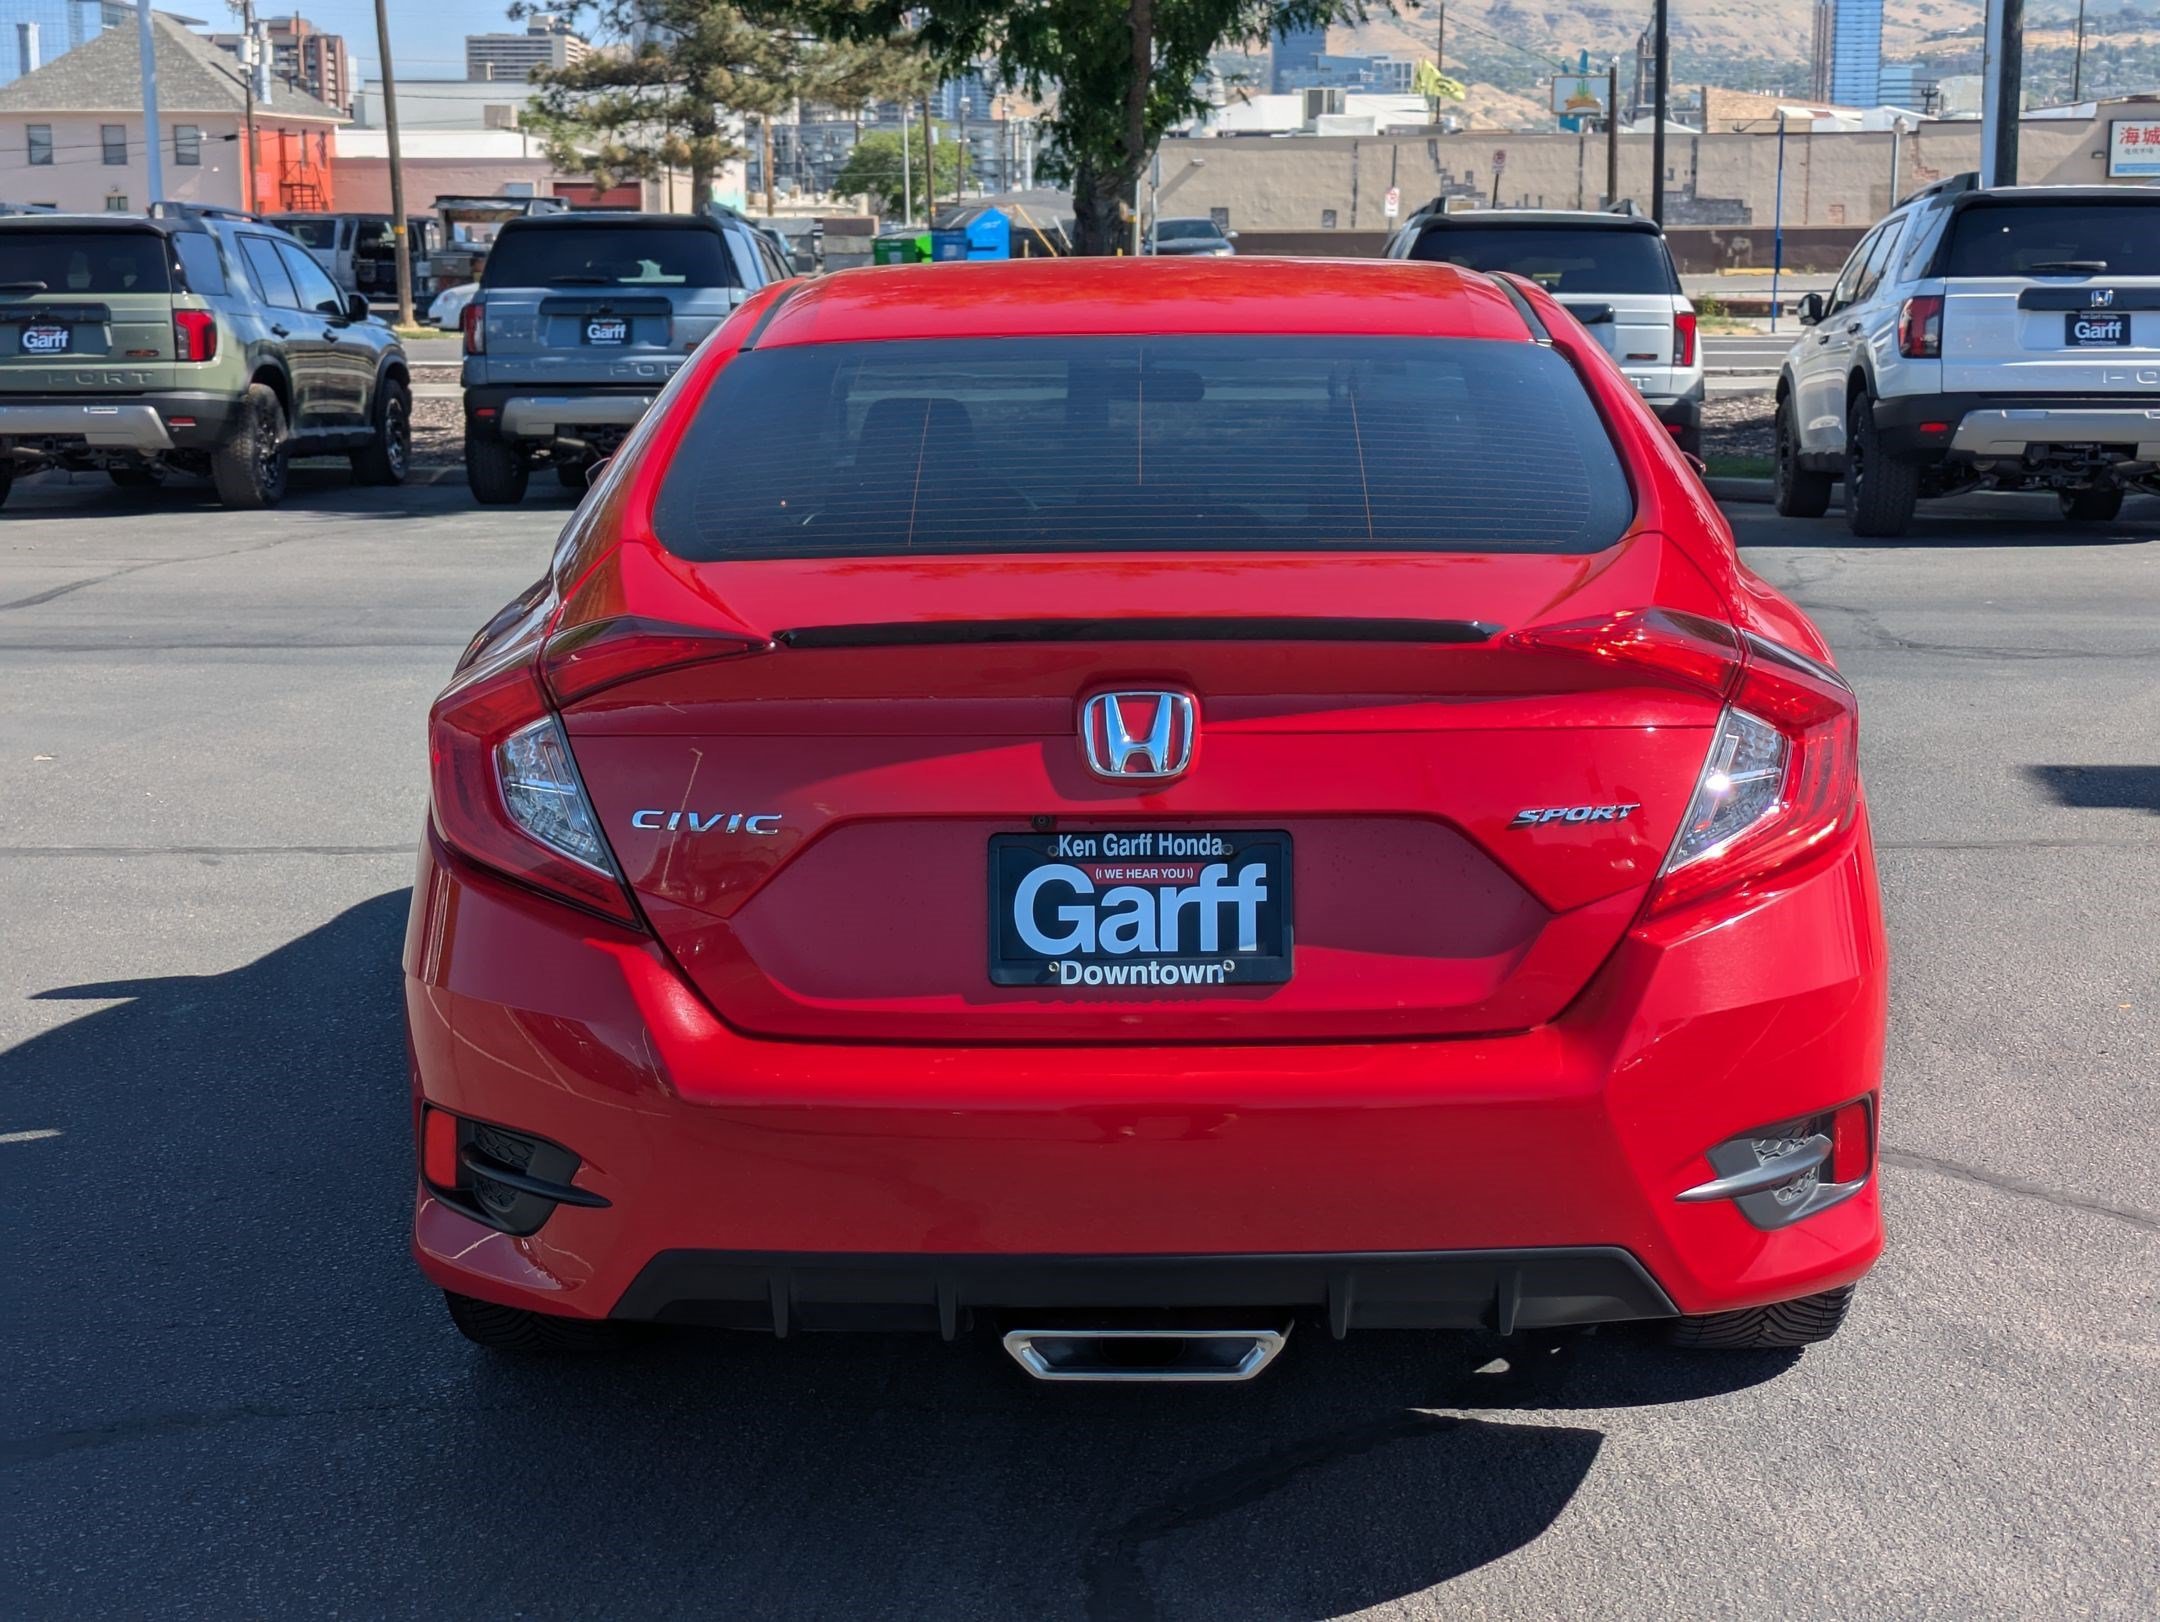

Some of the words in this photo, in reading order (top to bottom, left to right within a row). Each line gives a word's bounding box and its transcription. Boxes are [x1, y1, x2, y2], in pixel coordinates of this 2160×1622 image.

[22, 330, 69, 348] Garff
[587, 324, 627, 339] Garff
[2074, 321, 2122, 339] Garff
[631, 810, 783, 835] CIVIC
[1512, 803, 1641, 824] SPORT
[1058, 834, 1097, 857] Ken
[1103, 833, 1153, 857] Garff
[1158, 833, 1223, 856] Honda
[1104, 869, 1123, 879] WE
[1126, 869, 1158, 879] HEAR
[1161, 868, 1185, 879] YOU
[1013, 863, 1267, 956] Garff
[1060, 960, 1225, 985] Downtown
